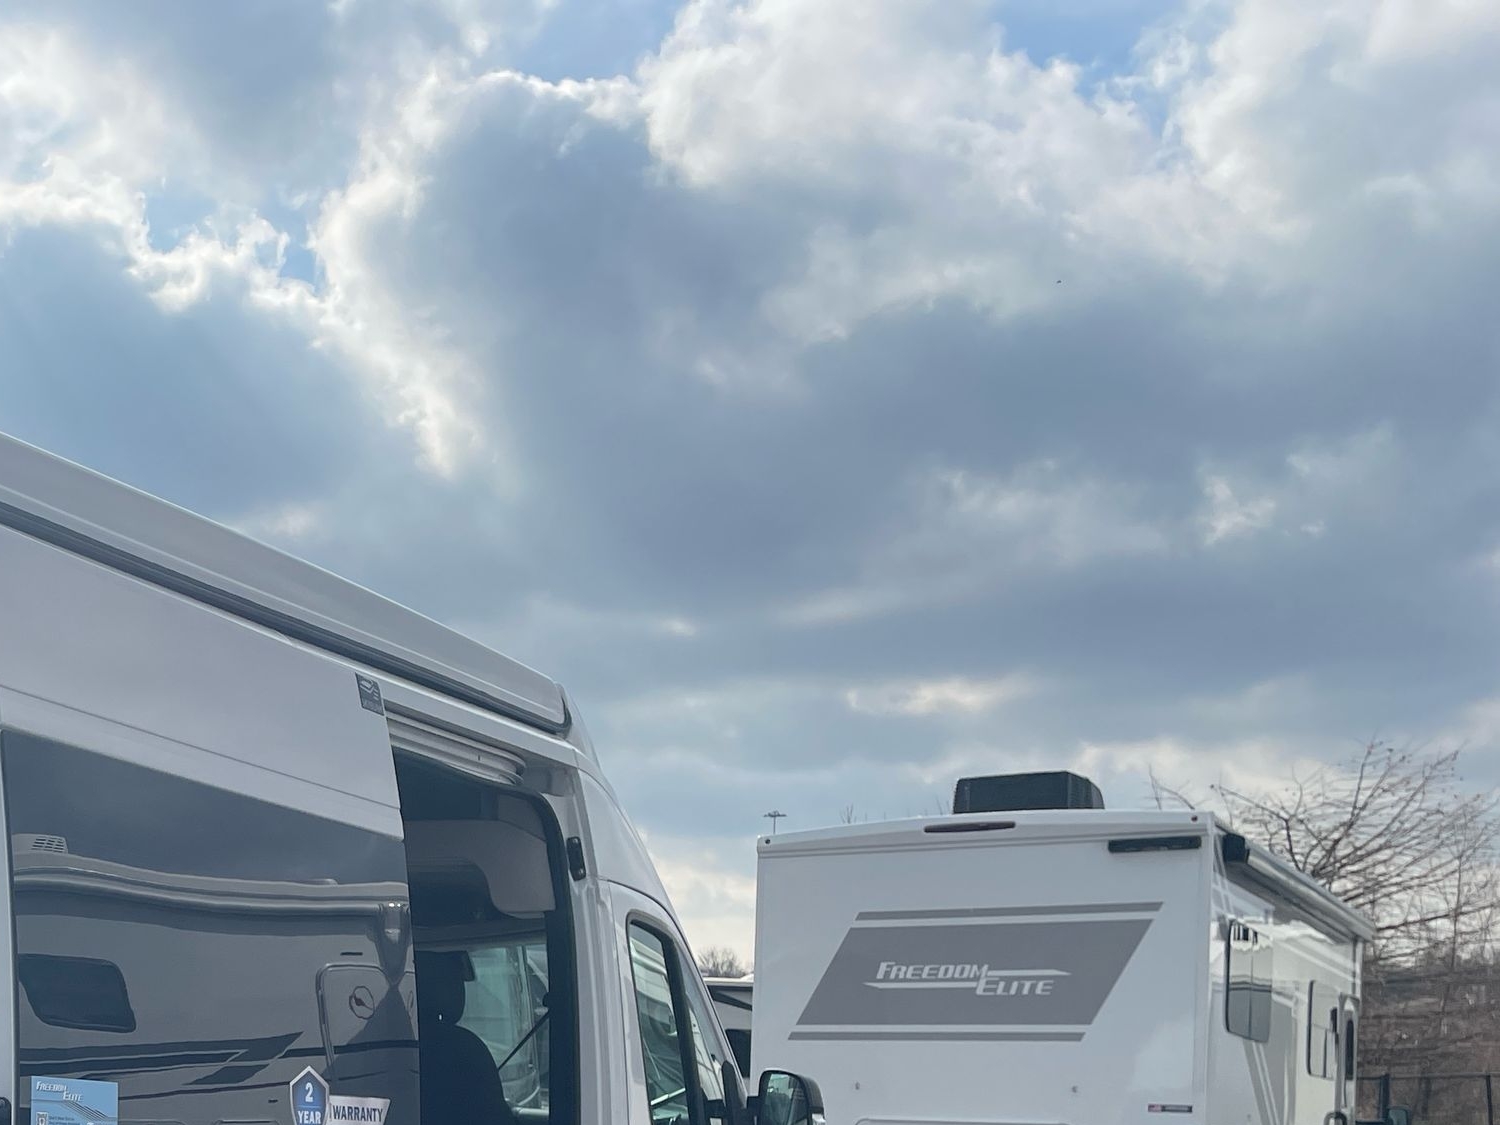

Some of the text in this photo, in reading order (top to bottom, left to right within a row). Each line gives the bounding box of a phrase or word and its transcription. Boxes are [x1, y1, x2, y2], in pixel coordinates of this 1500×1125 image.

[875, 961, 989, 980] FREEDOM
[975, 977, 1055, 996] ELITE
[304, 1082, 314, 1103] 2
[297, 1110, 322, 1125] YEAR
[332, 1105, 383, 1123] WARRANTY
